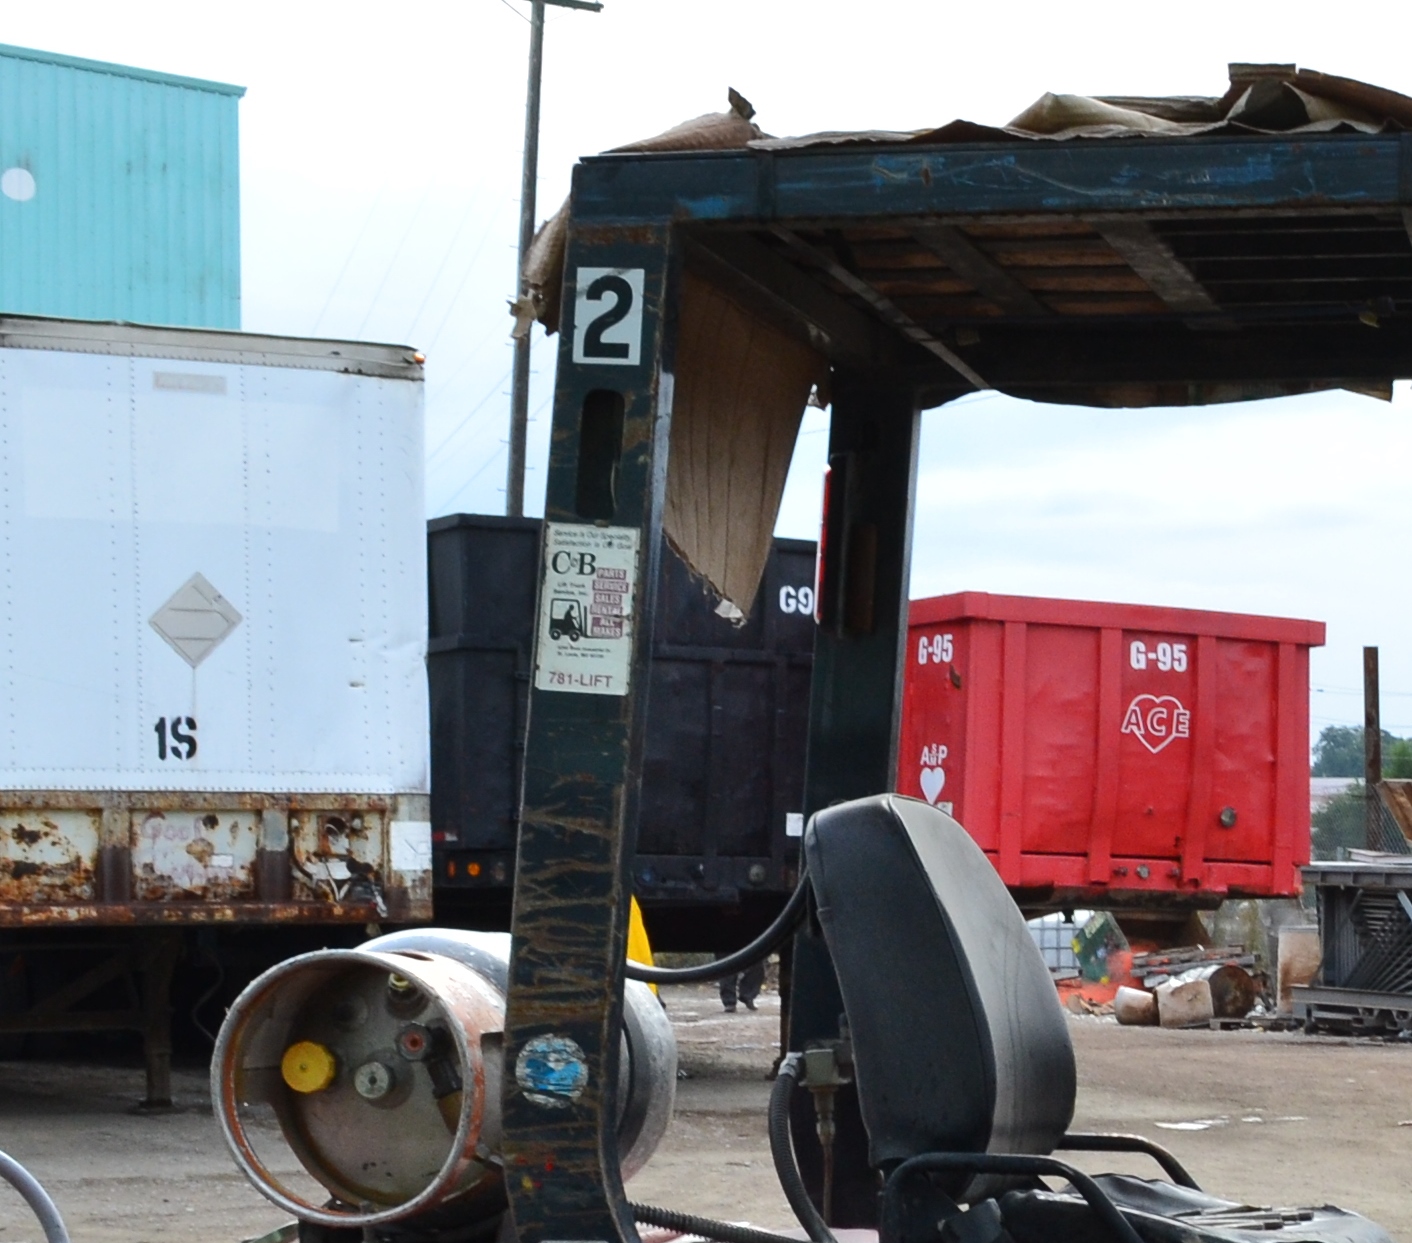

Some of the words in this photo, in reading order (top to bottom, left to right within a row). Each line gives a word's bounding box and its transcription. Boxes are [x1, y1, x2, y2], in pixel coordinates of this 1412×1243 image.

[583, 275, 633, 359] 2
[918, 634, 953, 665] G-95
[1129, 640, 1188, 672] G-95
[549, 670, 613, 688] 781-LIFT
[154, 715, 197, 761] 1S
[1121, 706, 1190, 738] ACE
